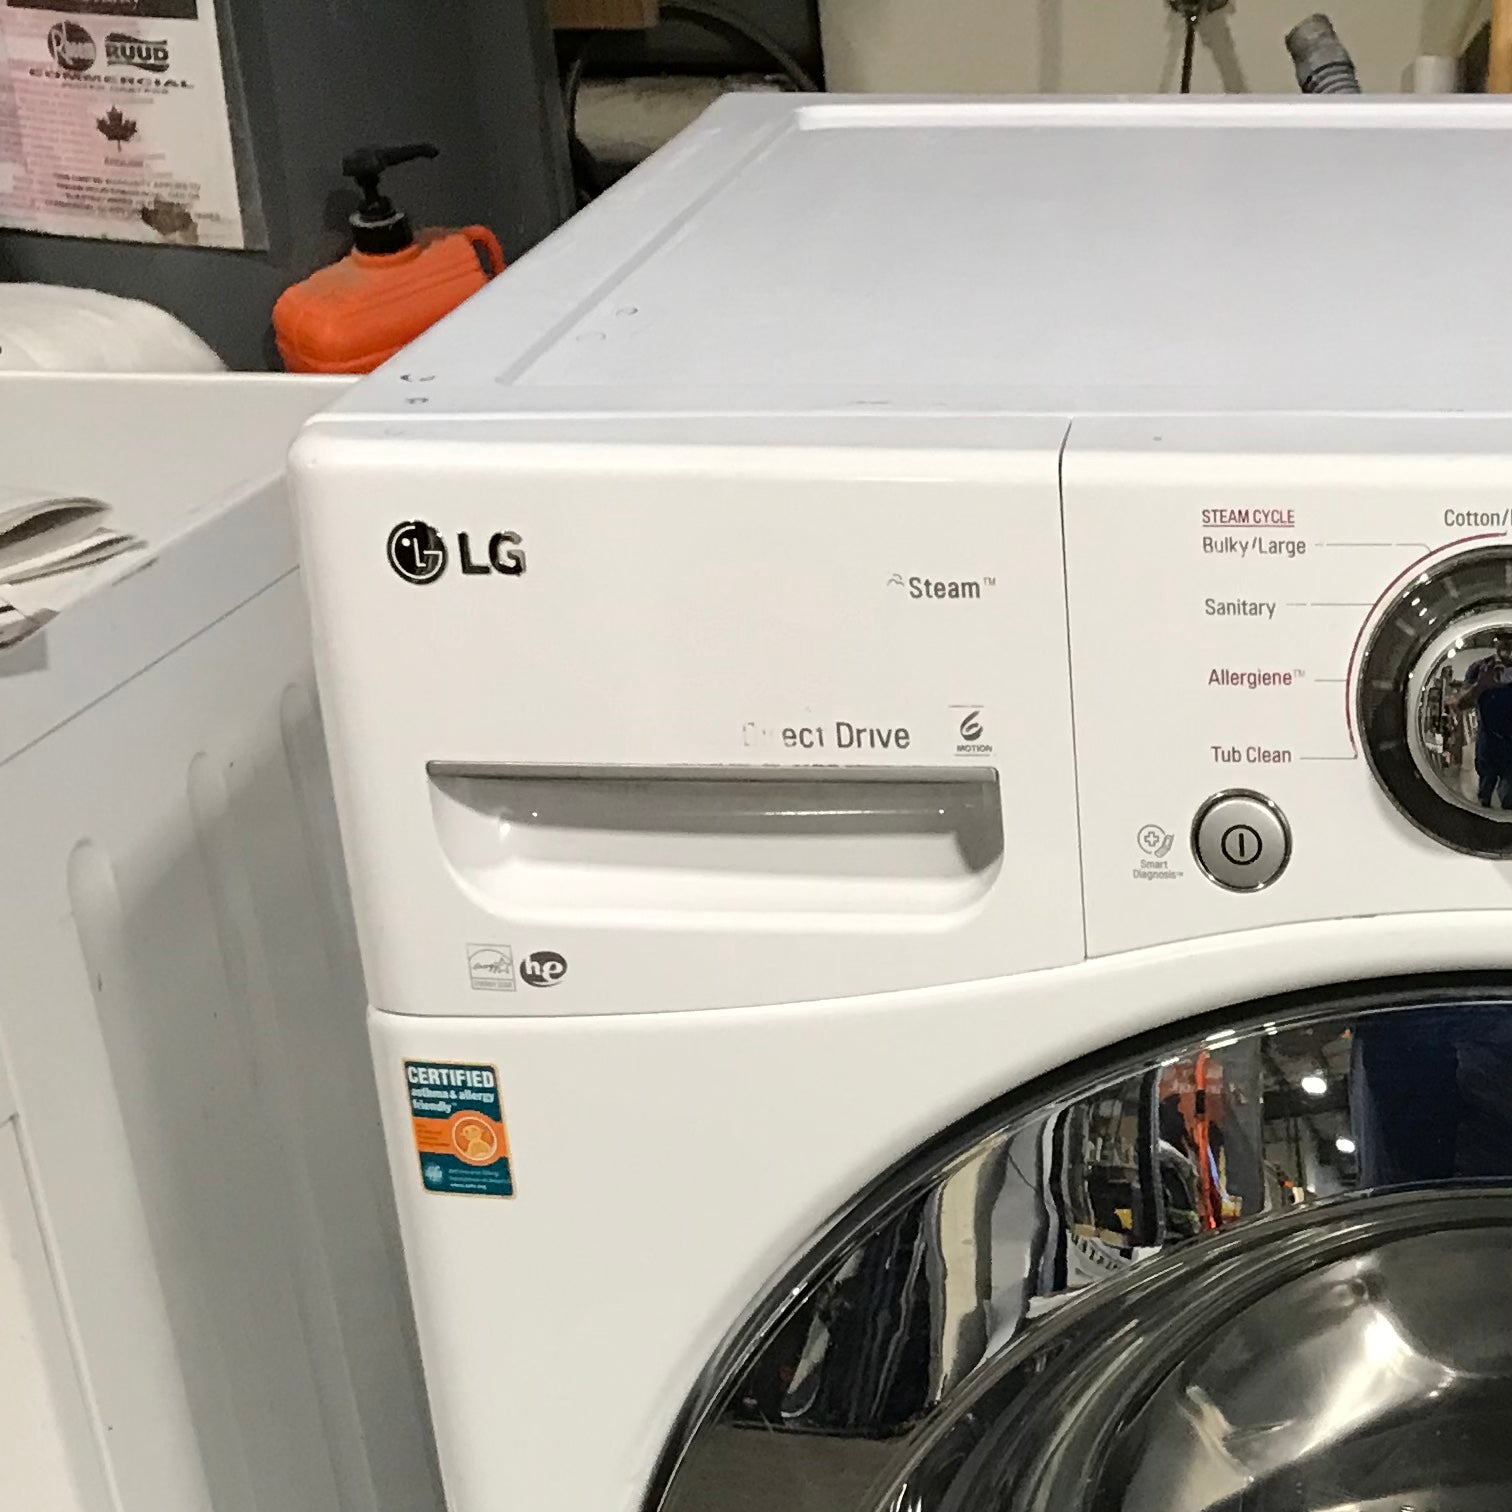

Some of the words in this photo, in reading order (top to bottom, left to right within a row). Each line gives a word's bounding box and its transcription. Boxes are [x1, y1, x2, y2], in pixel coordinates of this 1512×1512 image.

[1202, 509, 1250, 523] STEAM
[1252, 509, 1295, 524] CYCLE
[457, 530, 527, 577] LG
[1202, 536, 1306, 558] Bulky/Large
[1204, 598, 1276, 620] Sanitary
[835, 721, 911, 749] Drive
[956, 744, 993, 754] MOTION
[1210, 746, 1242, 763] Tub
[1246, 746, 1292, 763] Clean
[1140, 859, 1168, 869] Smart
[407, 1066, 495, 1088] CERTIFIED
